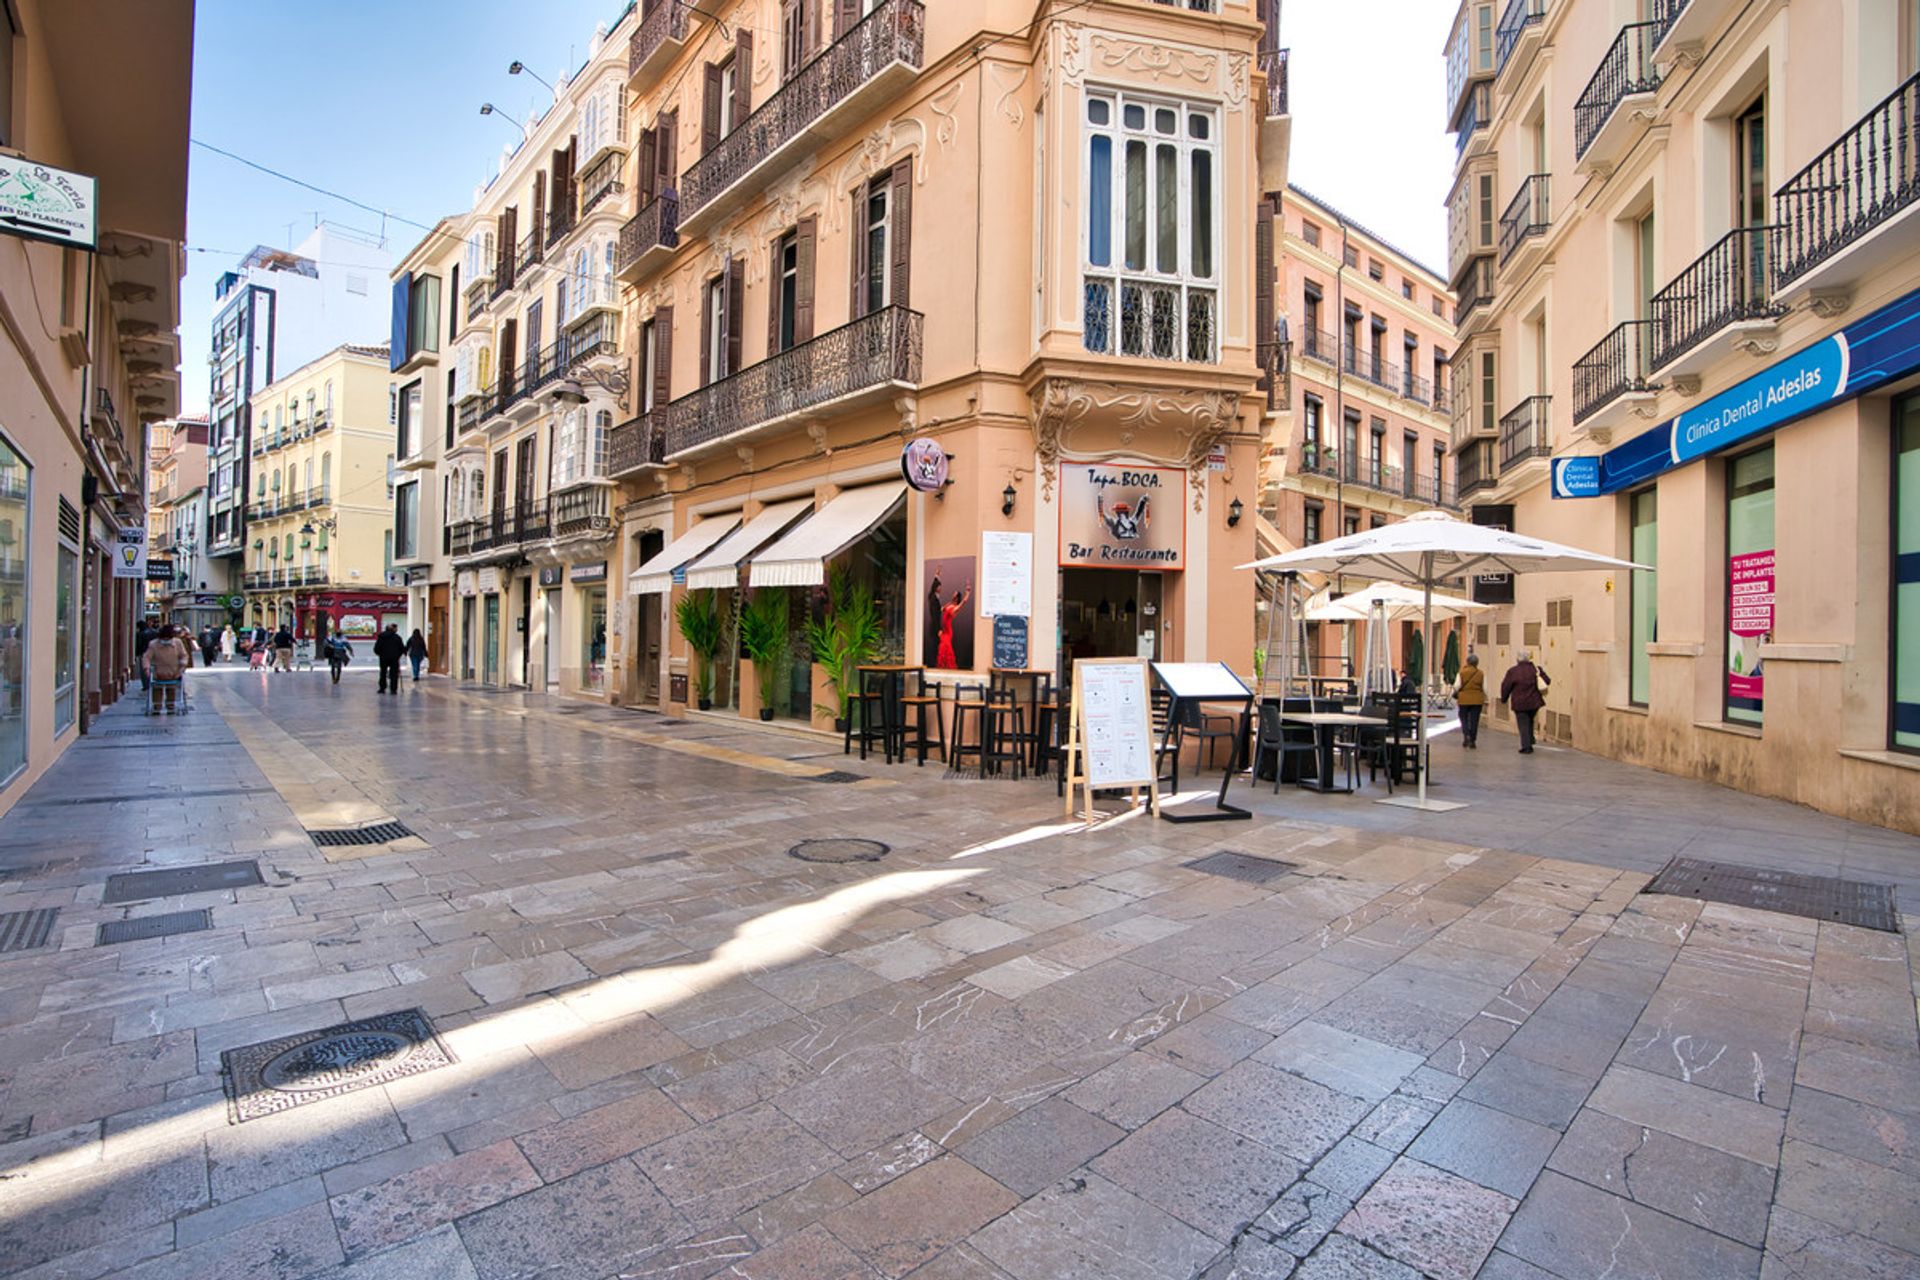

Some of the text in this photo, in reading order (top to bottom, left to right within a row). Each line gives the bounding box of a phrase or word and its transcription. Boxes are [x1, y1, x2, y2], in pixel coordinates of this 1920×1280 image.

[56, 176, 86, 209] Feria
[32, 212, 85, 229] FLAMENCA
[1686, 367, 1822, 443] Clínica Dental Adeslas
[1069, 543, 1177, 561] Bar Restaurante
[1733, 561, 1741, 569] TU
[1733, 571, 1741, 580] DE
